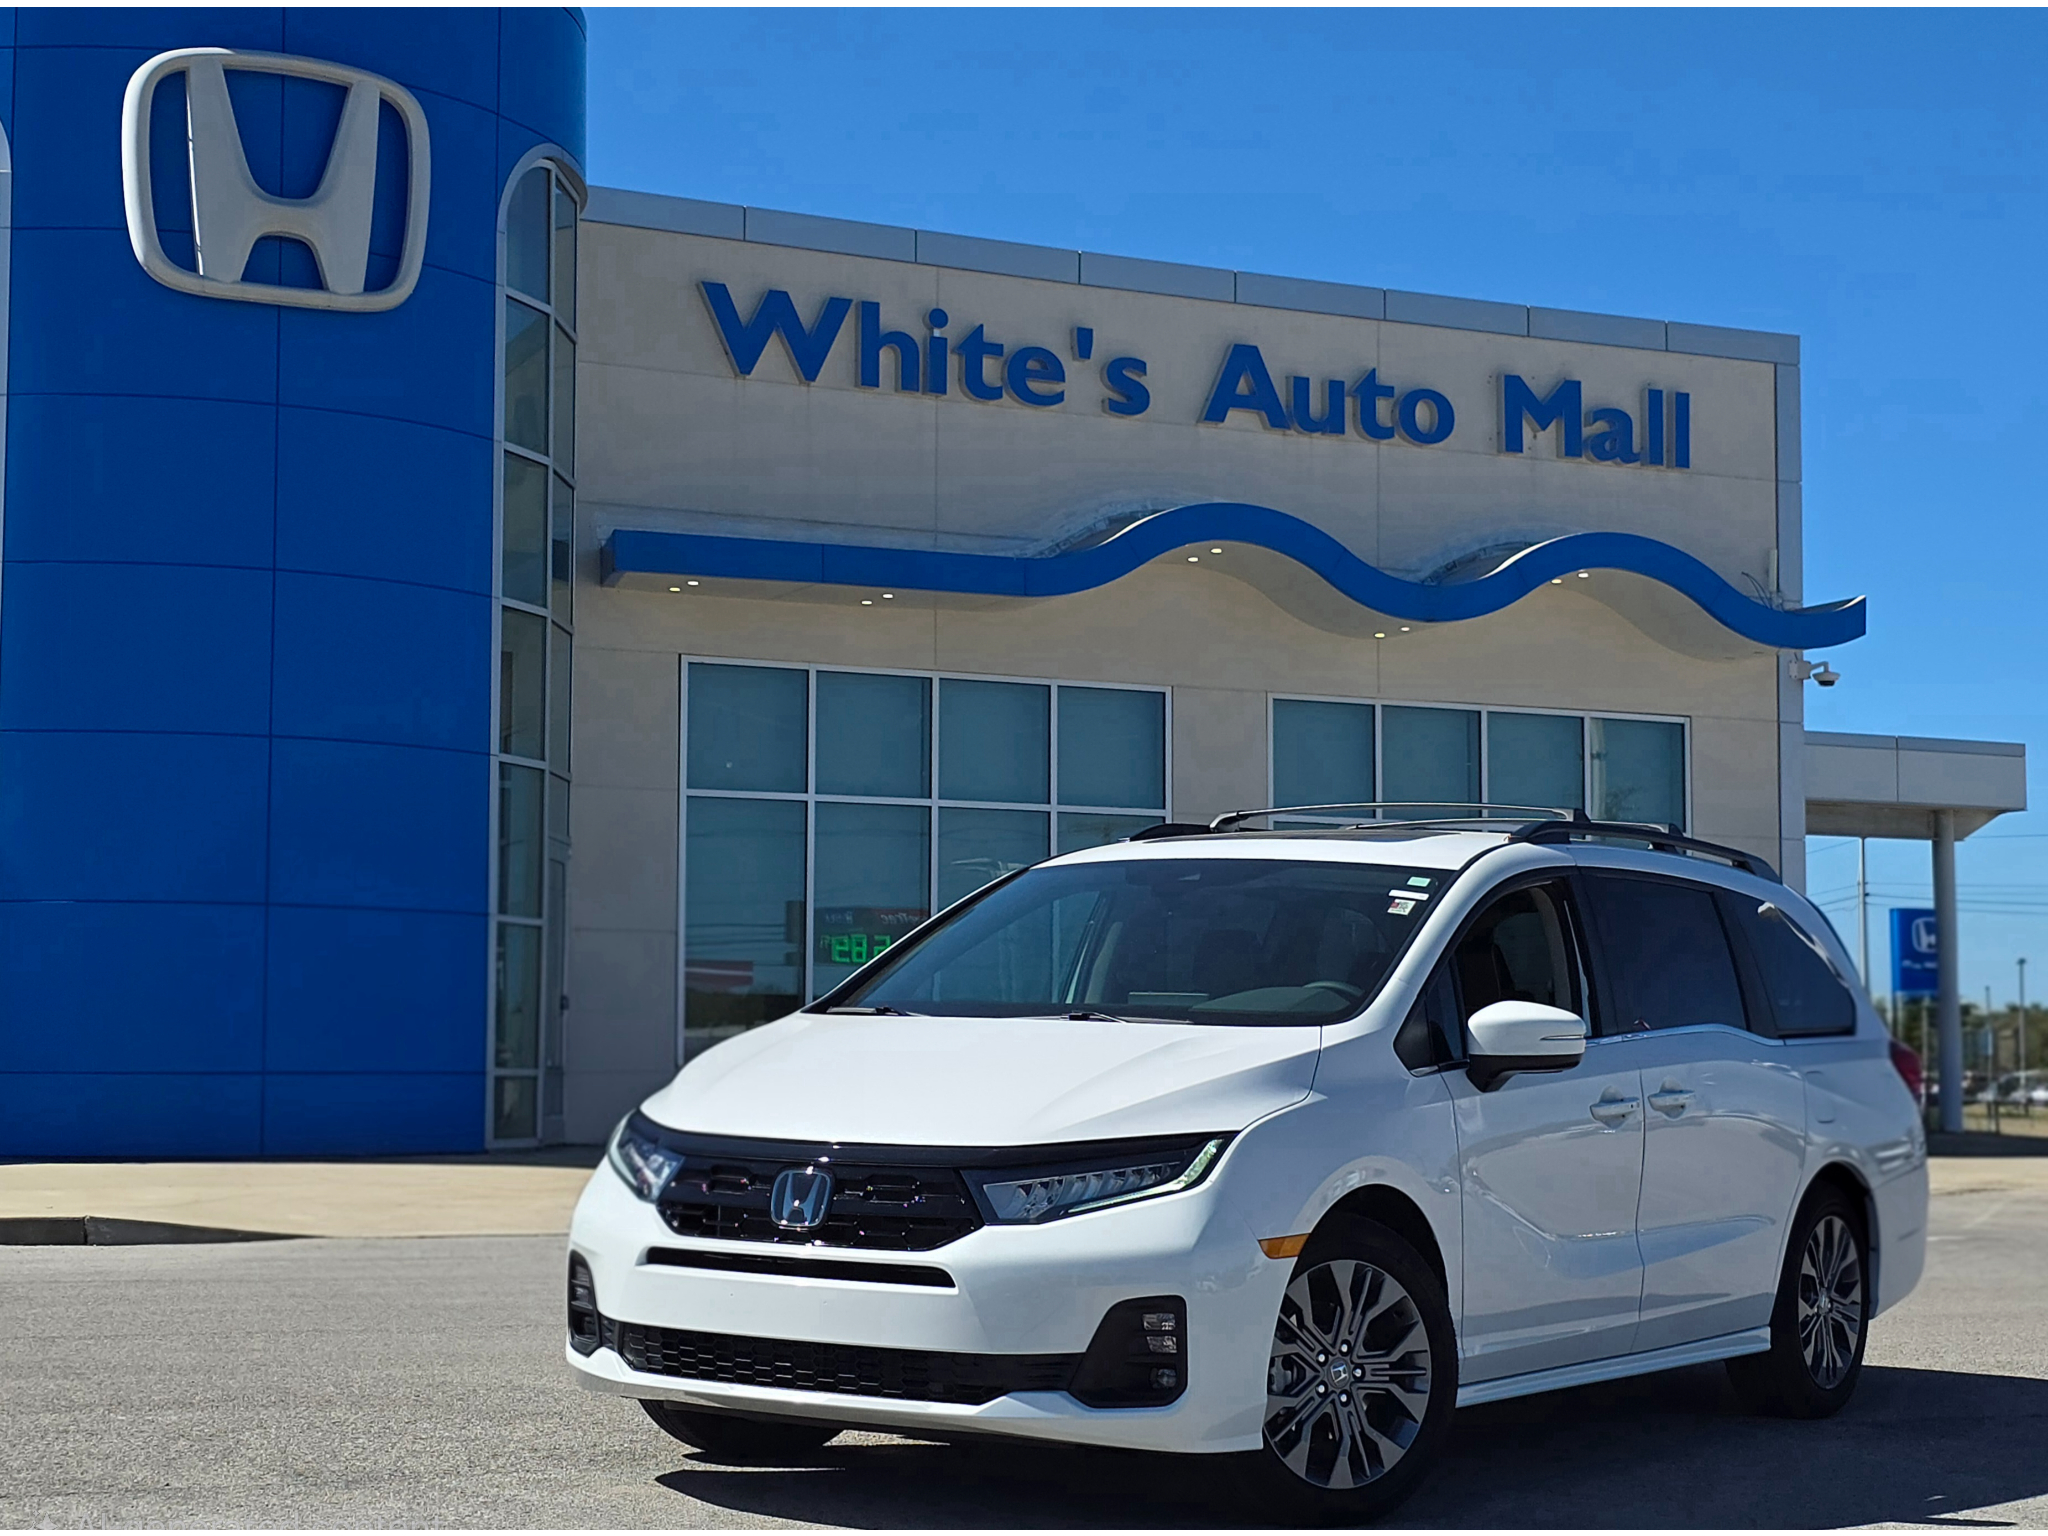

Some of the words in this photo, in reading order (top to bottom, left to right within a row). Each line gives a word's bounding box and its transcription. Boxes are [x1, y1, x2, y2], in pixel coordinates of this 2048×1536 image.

[701, 281, 1151, 416] White's
[1200, 343, 1455, 445] Auto
[1501, 374, 1690, 469] Mall
